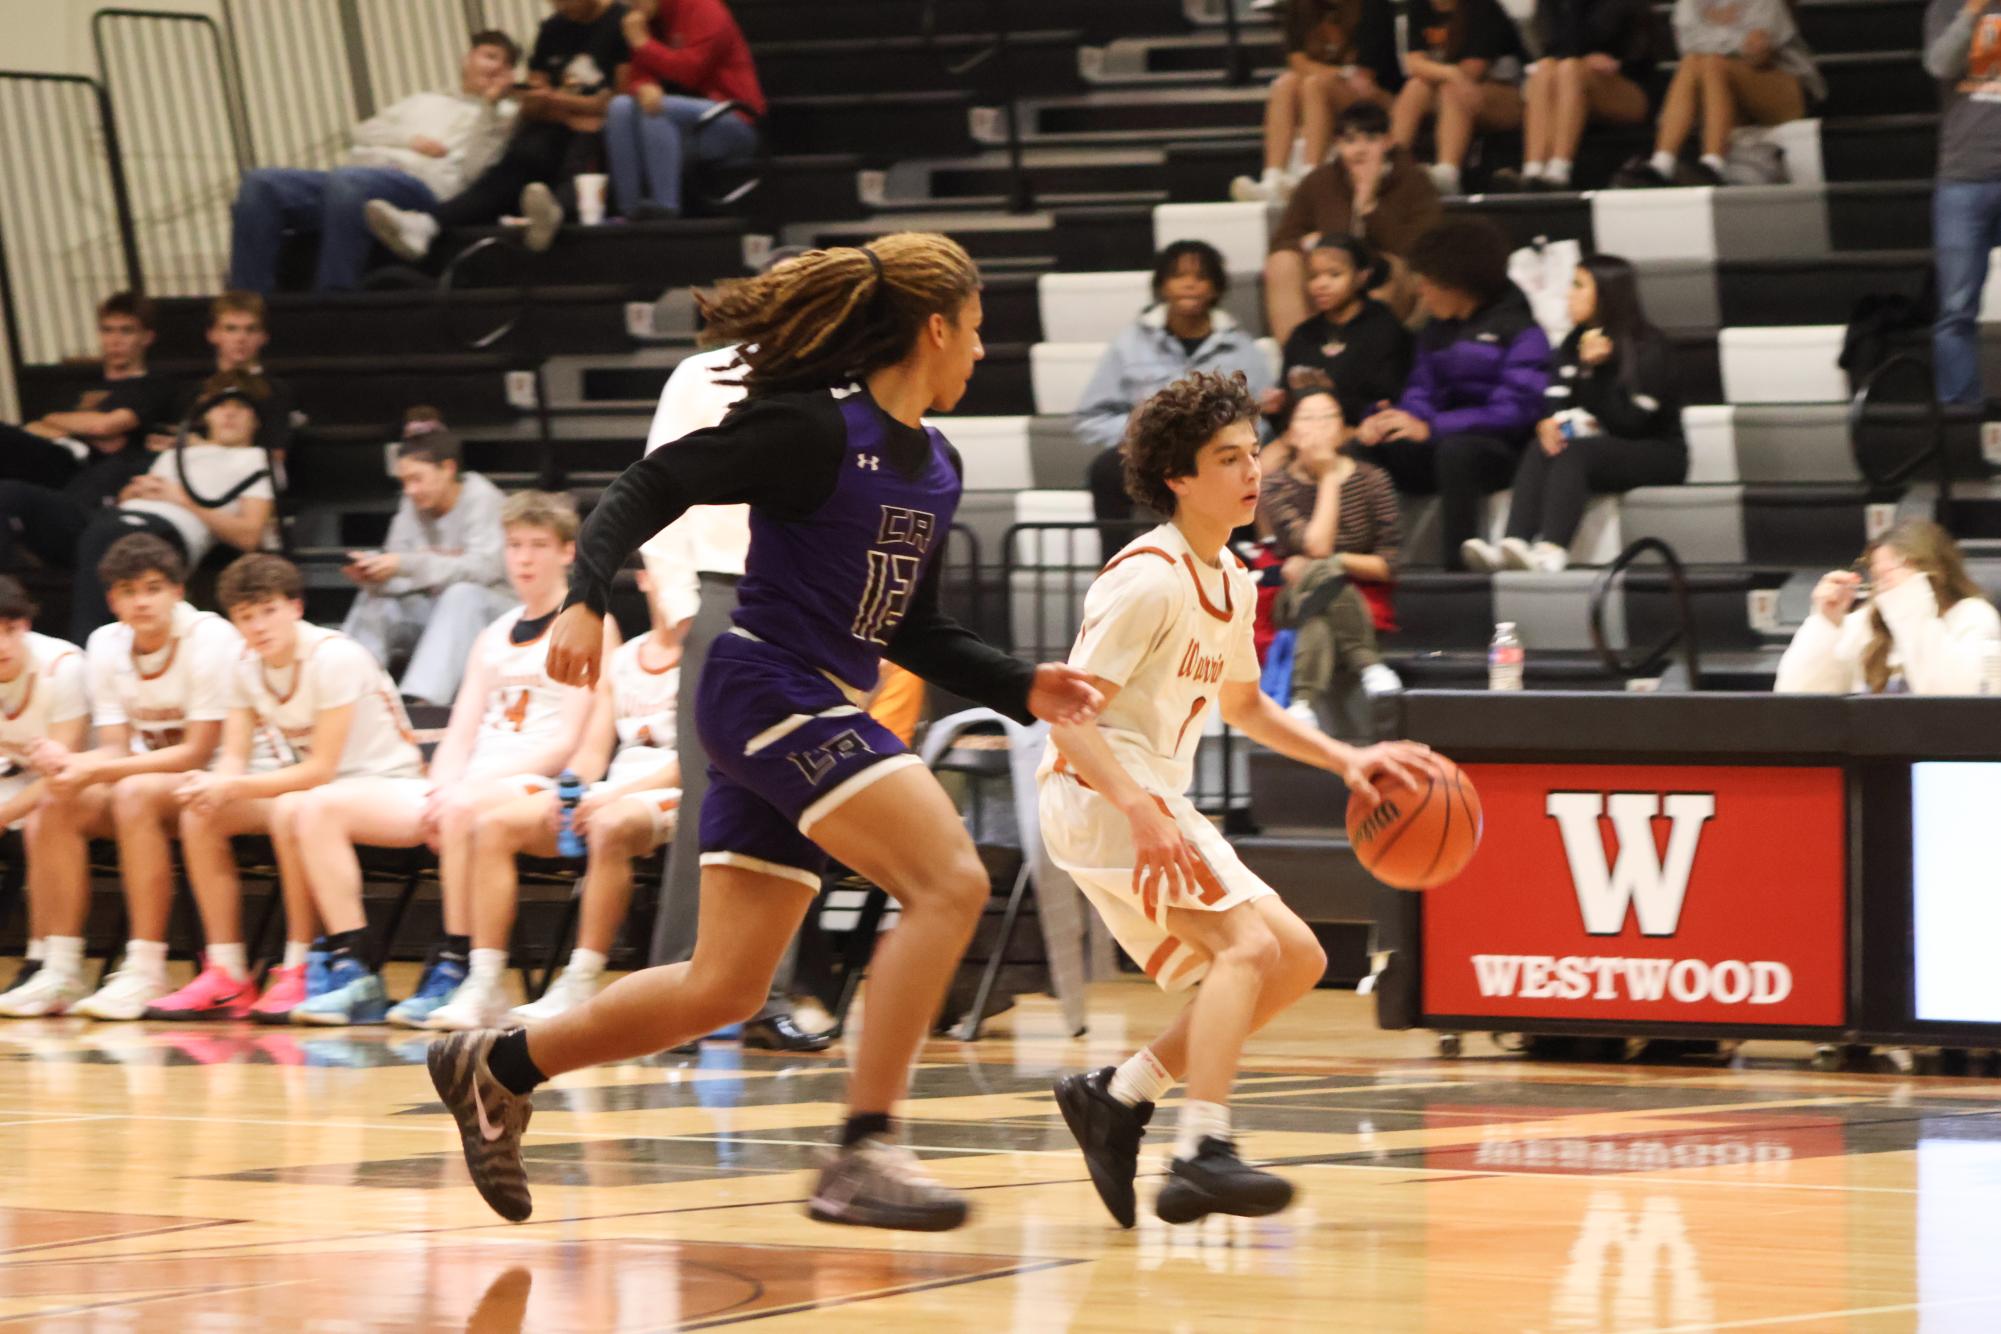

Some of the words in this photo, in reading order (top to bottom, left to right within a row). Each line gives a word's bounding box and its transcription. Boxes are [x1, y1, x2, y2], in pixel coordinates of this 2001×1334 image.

[876, 504, 936, 554] CR
[852, 550, 920, 646] 12
[1546, 789, 1716, 938] W
[1470, 953, 1793, 1005] WESTWOOD
